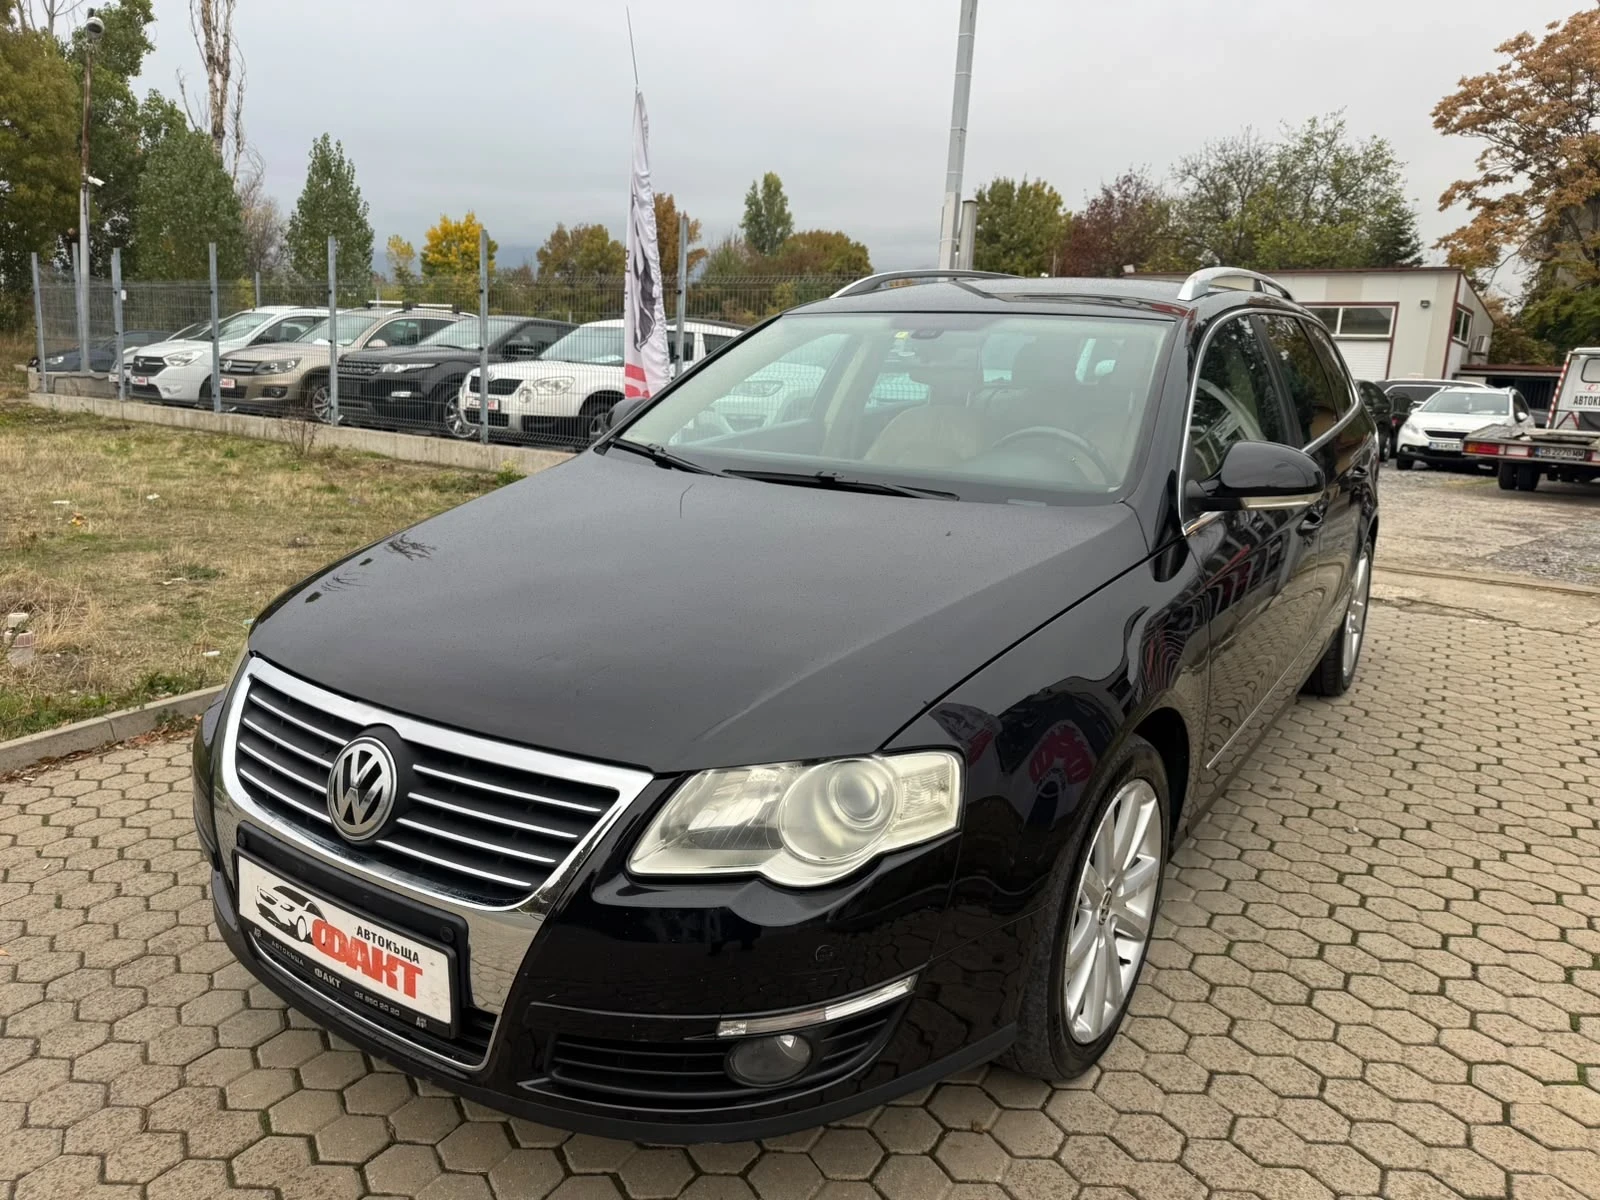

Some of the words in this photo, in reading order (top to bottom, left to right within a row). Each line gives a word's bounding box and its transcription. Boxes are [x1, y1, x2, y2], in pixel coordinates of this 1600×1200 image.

[312, 918, 423, 999] ФАКТ
[356, 925, 420, 964] АВТОКЪЩА
[314, 968, 342, 989] ФАКТ
